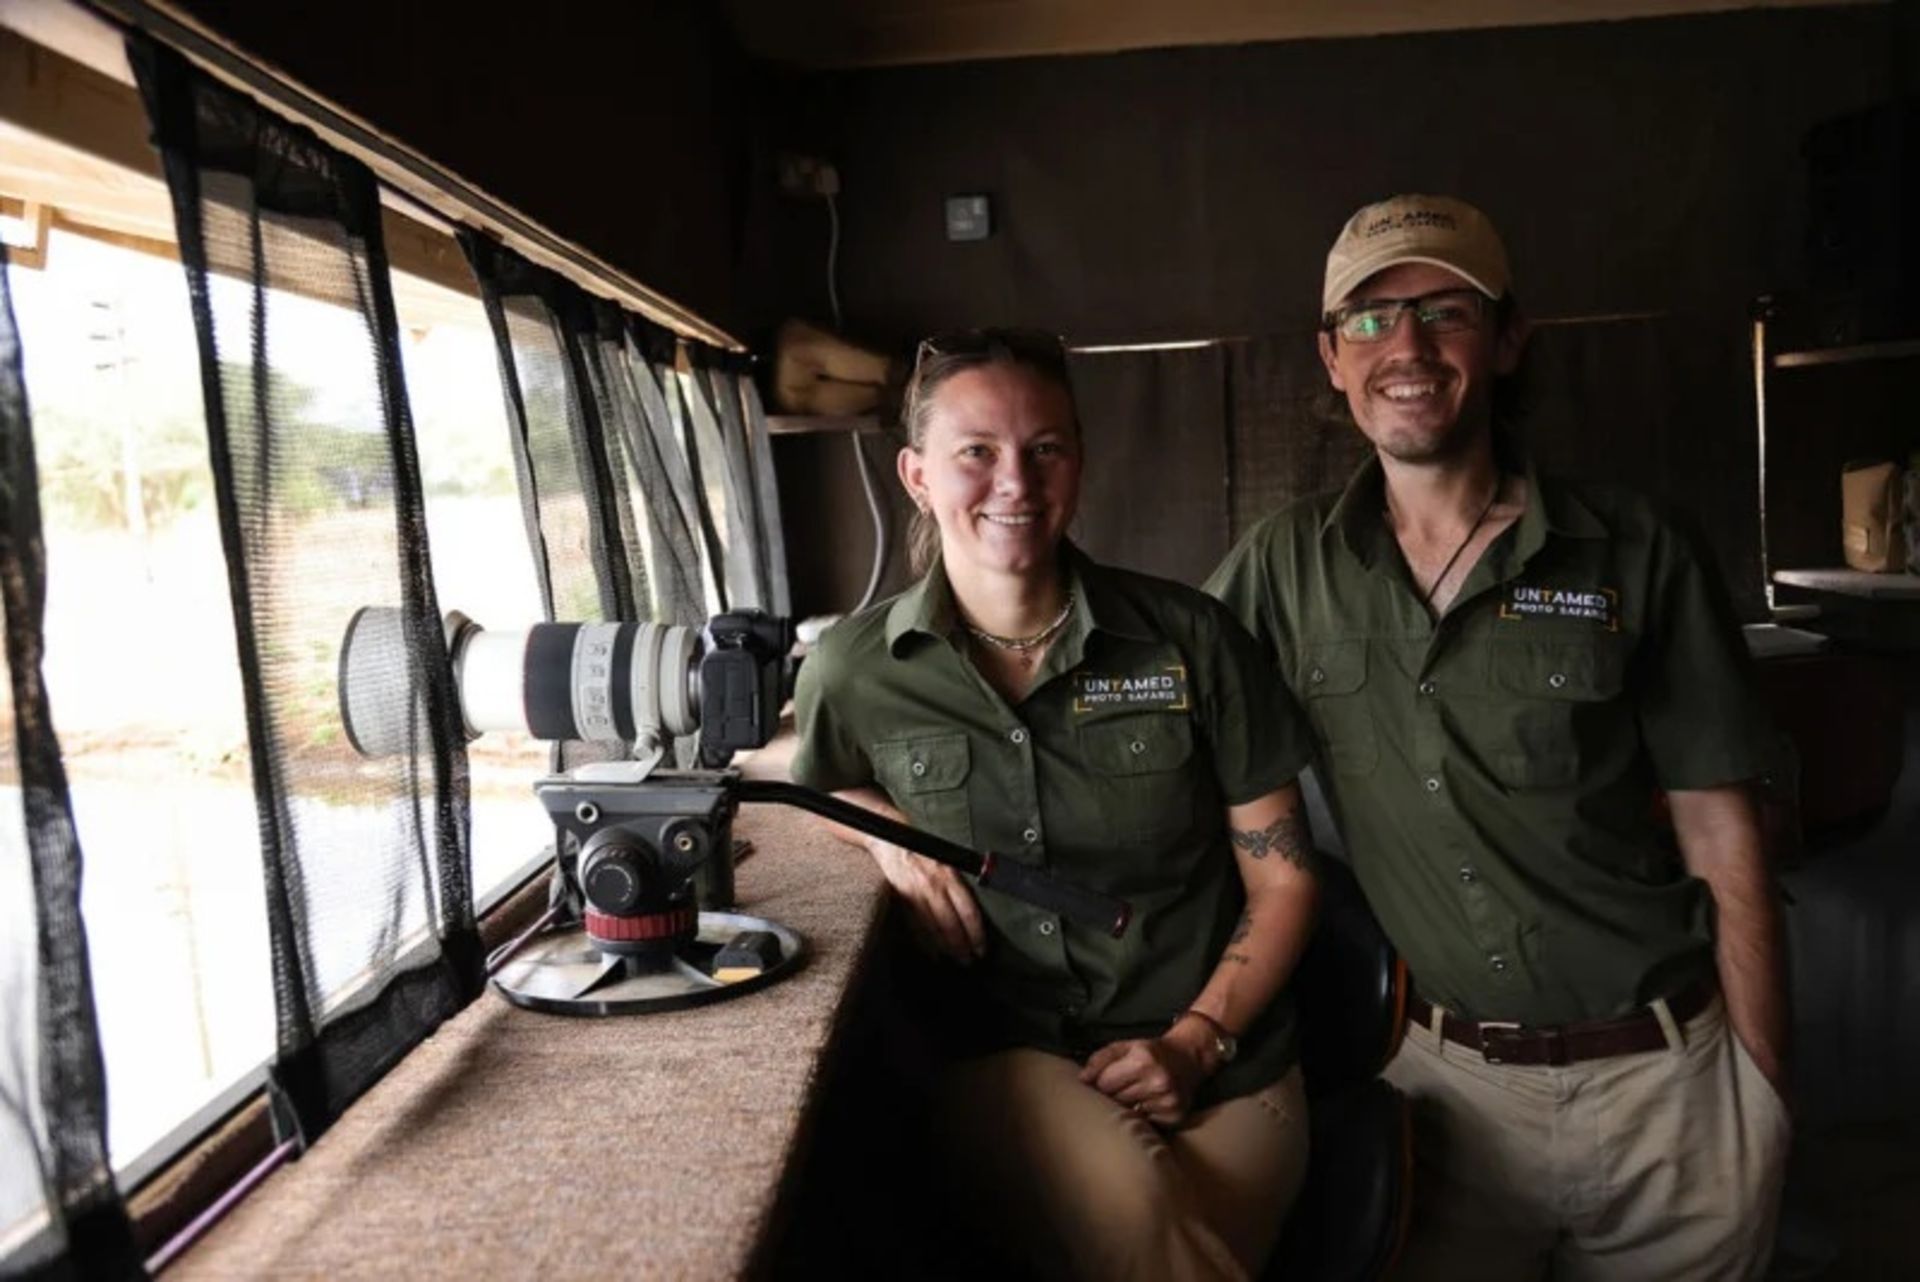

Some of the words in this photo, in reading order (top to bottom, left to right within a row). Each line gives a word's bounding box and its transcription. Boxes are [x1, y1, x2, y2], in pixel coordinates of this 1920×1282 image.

[1513, 587, 1607, 608] UNTAMED
[1512, 602, 1554, 613] PHOTO
[1084, 676, 1174, 692] UNTAMED
[1084, 693, 1122, 702] PHOTO
[1128, 691, 1176, 701] SAFARIS
